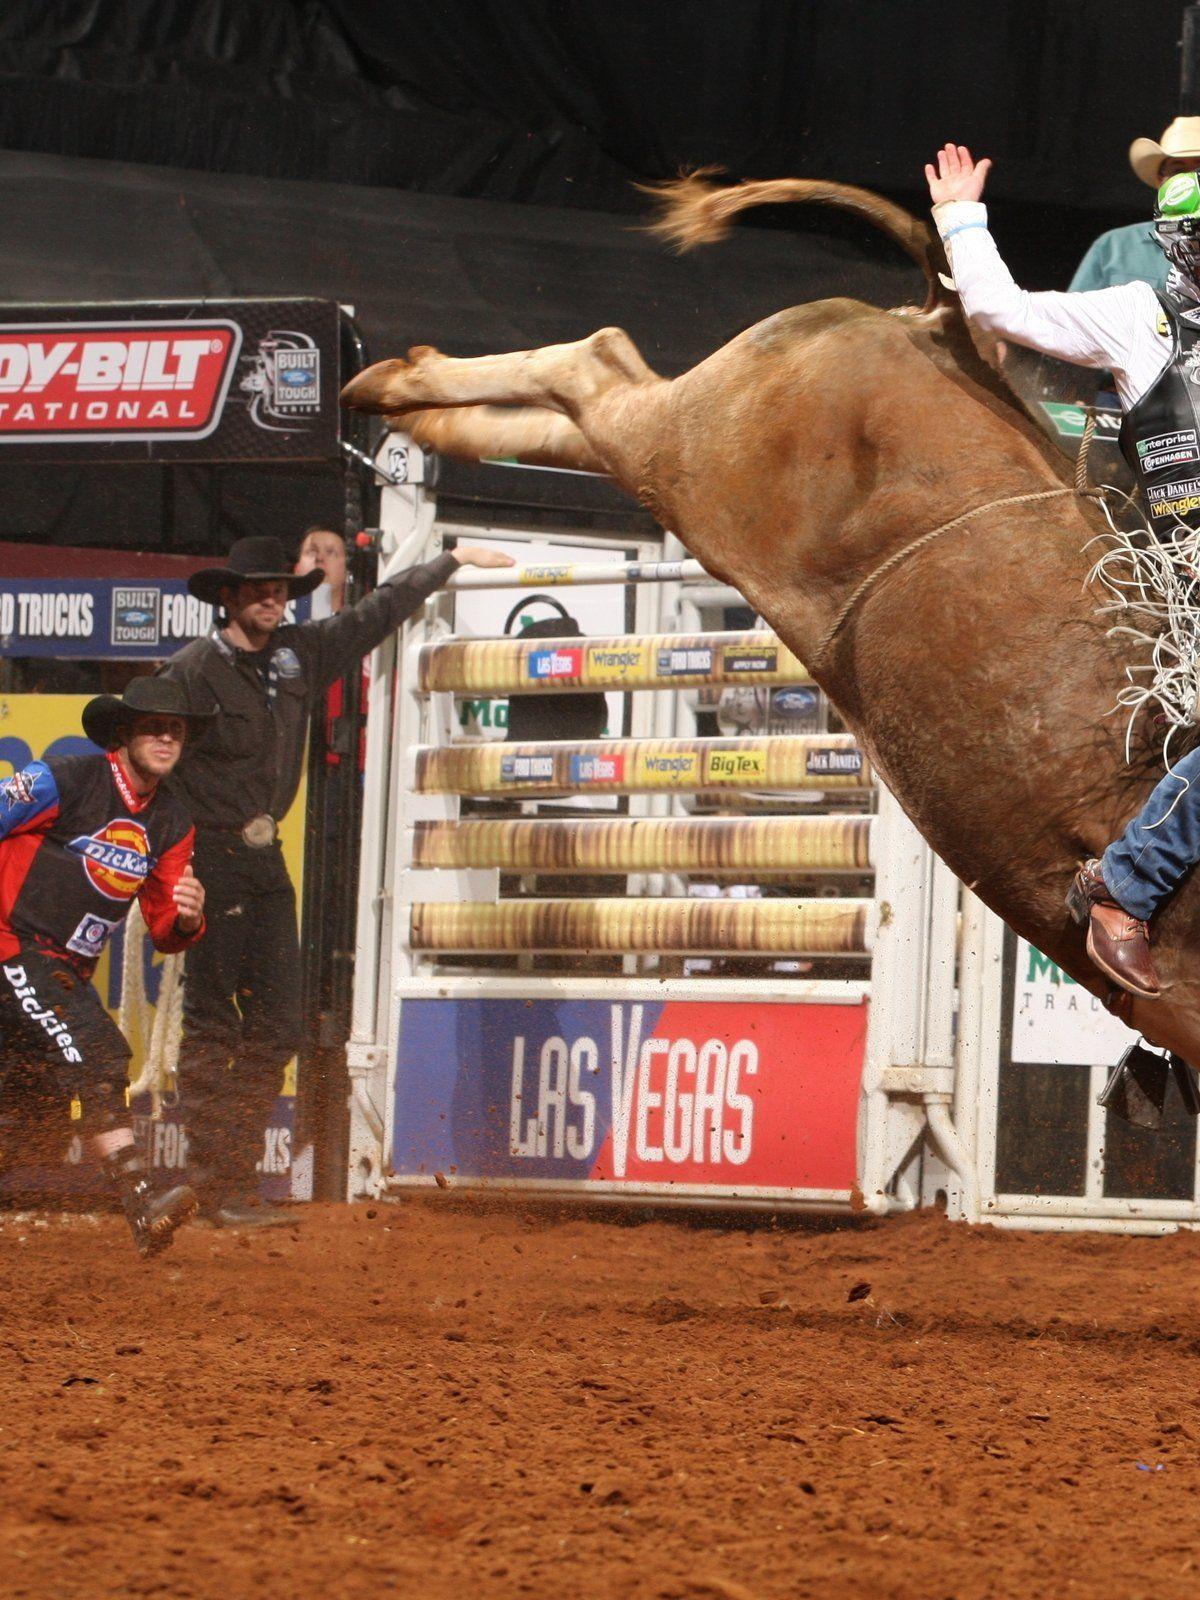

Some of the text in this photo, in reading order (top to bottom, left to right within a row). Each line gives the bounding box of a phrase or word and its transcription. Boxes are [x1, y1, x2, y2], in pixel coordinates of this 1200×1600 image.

[278, 353, 316, 369] BUILT
[278, 387, 317, 400] TOUGH
[1144, 450, 1193, 471] COPENHAGEN
[116, 592, 155, 608] BUILT
[18, 593, 94, 637] TRUCKS
[161, 594, 213, 637] FORD
[115, 626, 155, 641] TOUGH
[592, 651, 642, 674] Wrangler
[644, 756, 694, 780] Wrangler
[3, 963, 83, 1065] Dickies
[508, 1003, 759, 1178] LAS VEGAS
